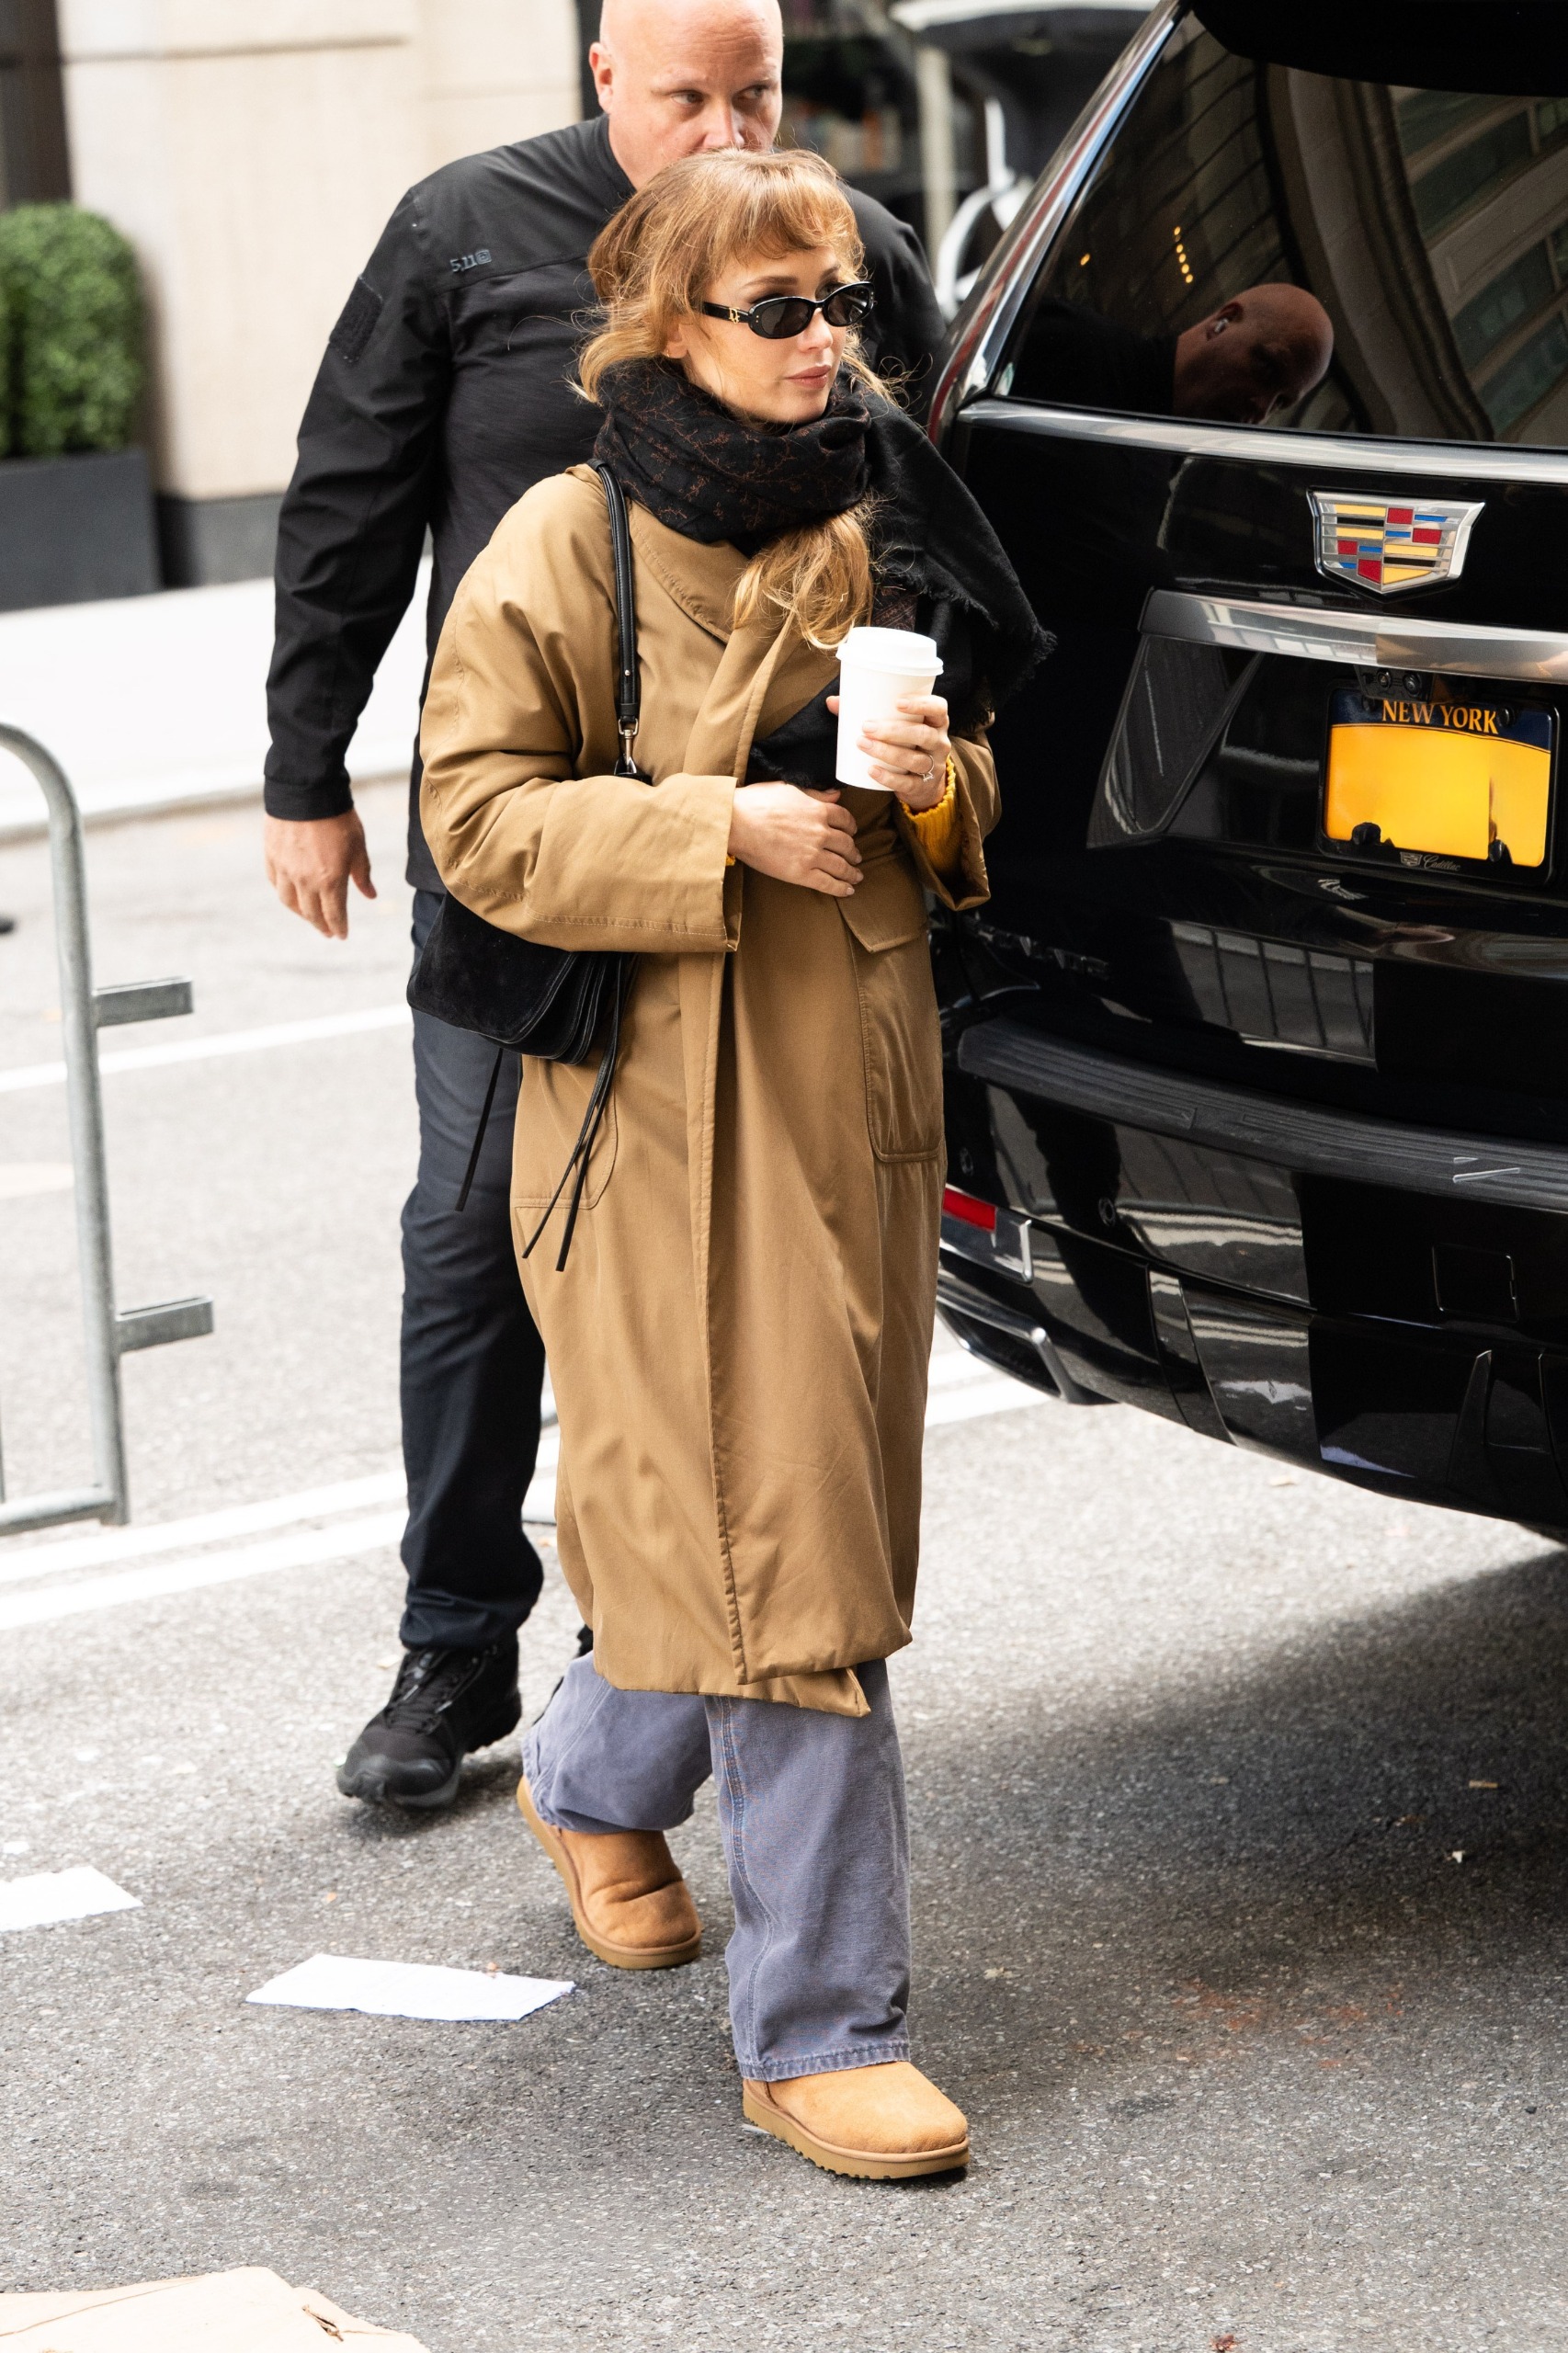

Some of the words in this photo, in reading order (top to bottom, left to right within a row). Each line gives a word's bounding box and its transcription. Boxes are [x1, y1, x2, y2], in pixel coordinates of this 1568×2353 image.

[1381, 699, 1435, 724] NEW
[1439, 704, 1499, 734] YORK
[1423, 854, 1461, 872] Cadillac
